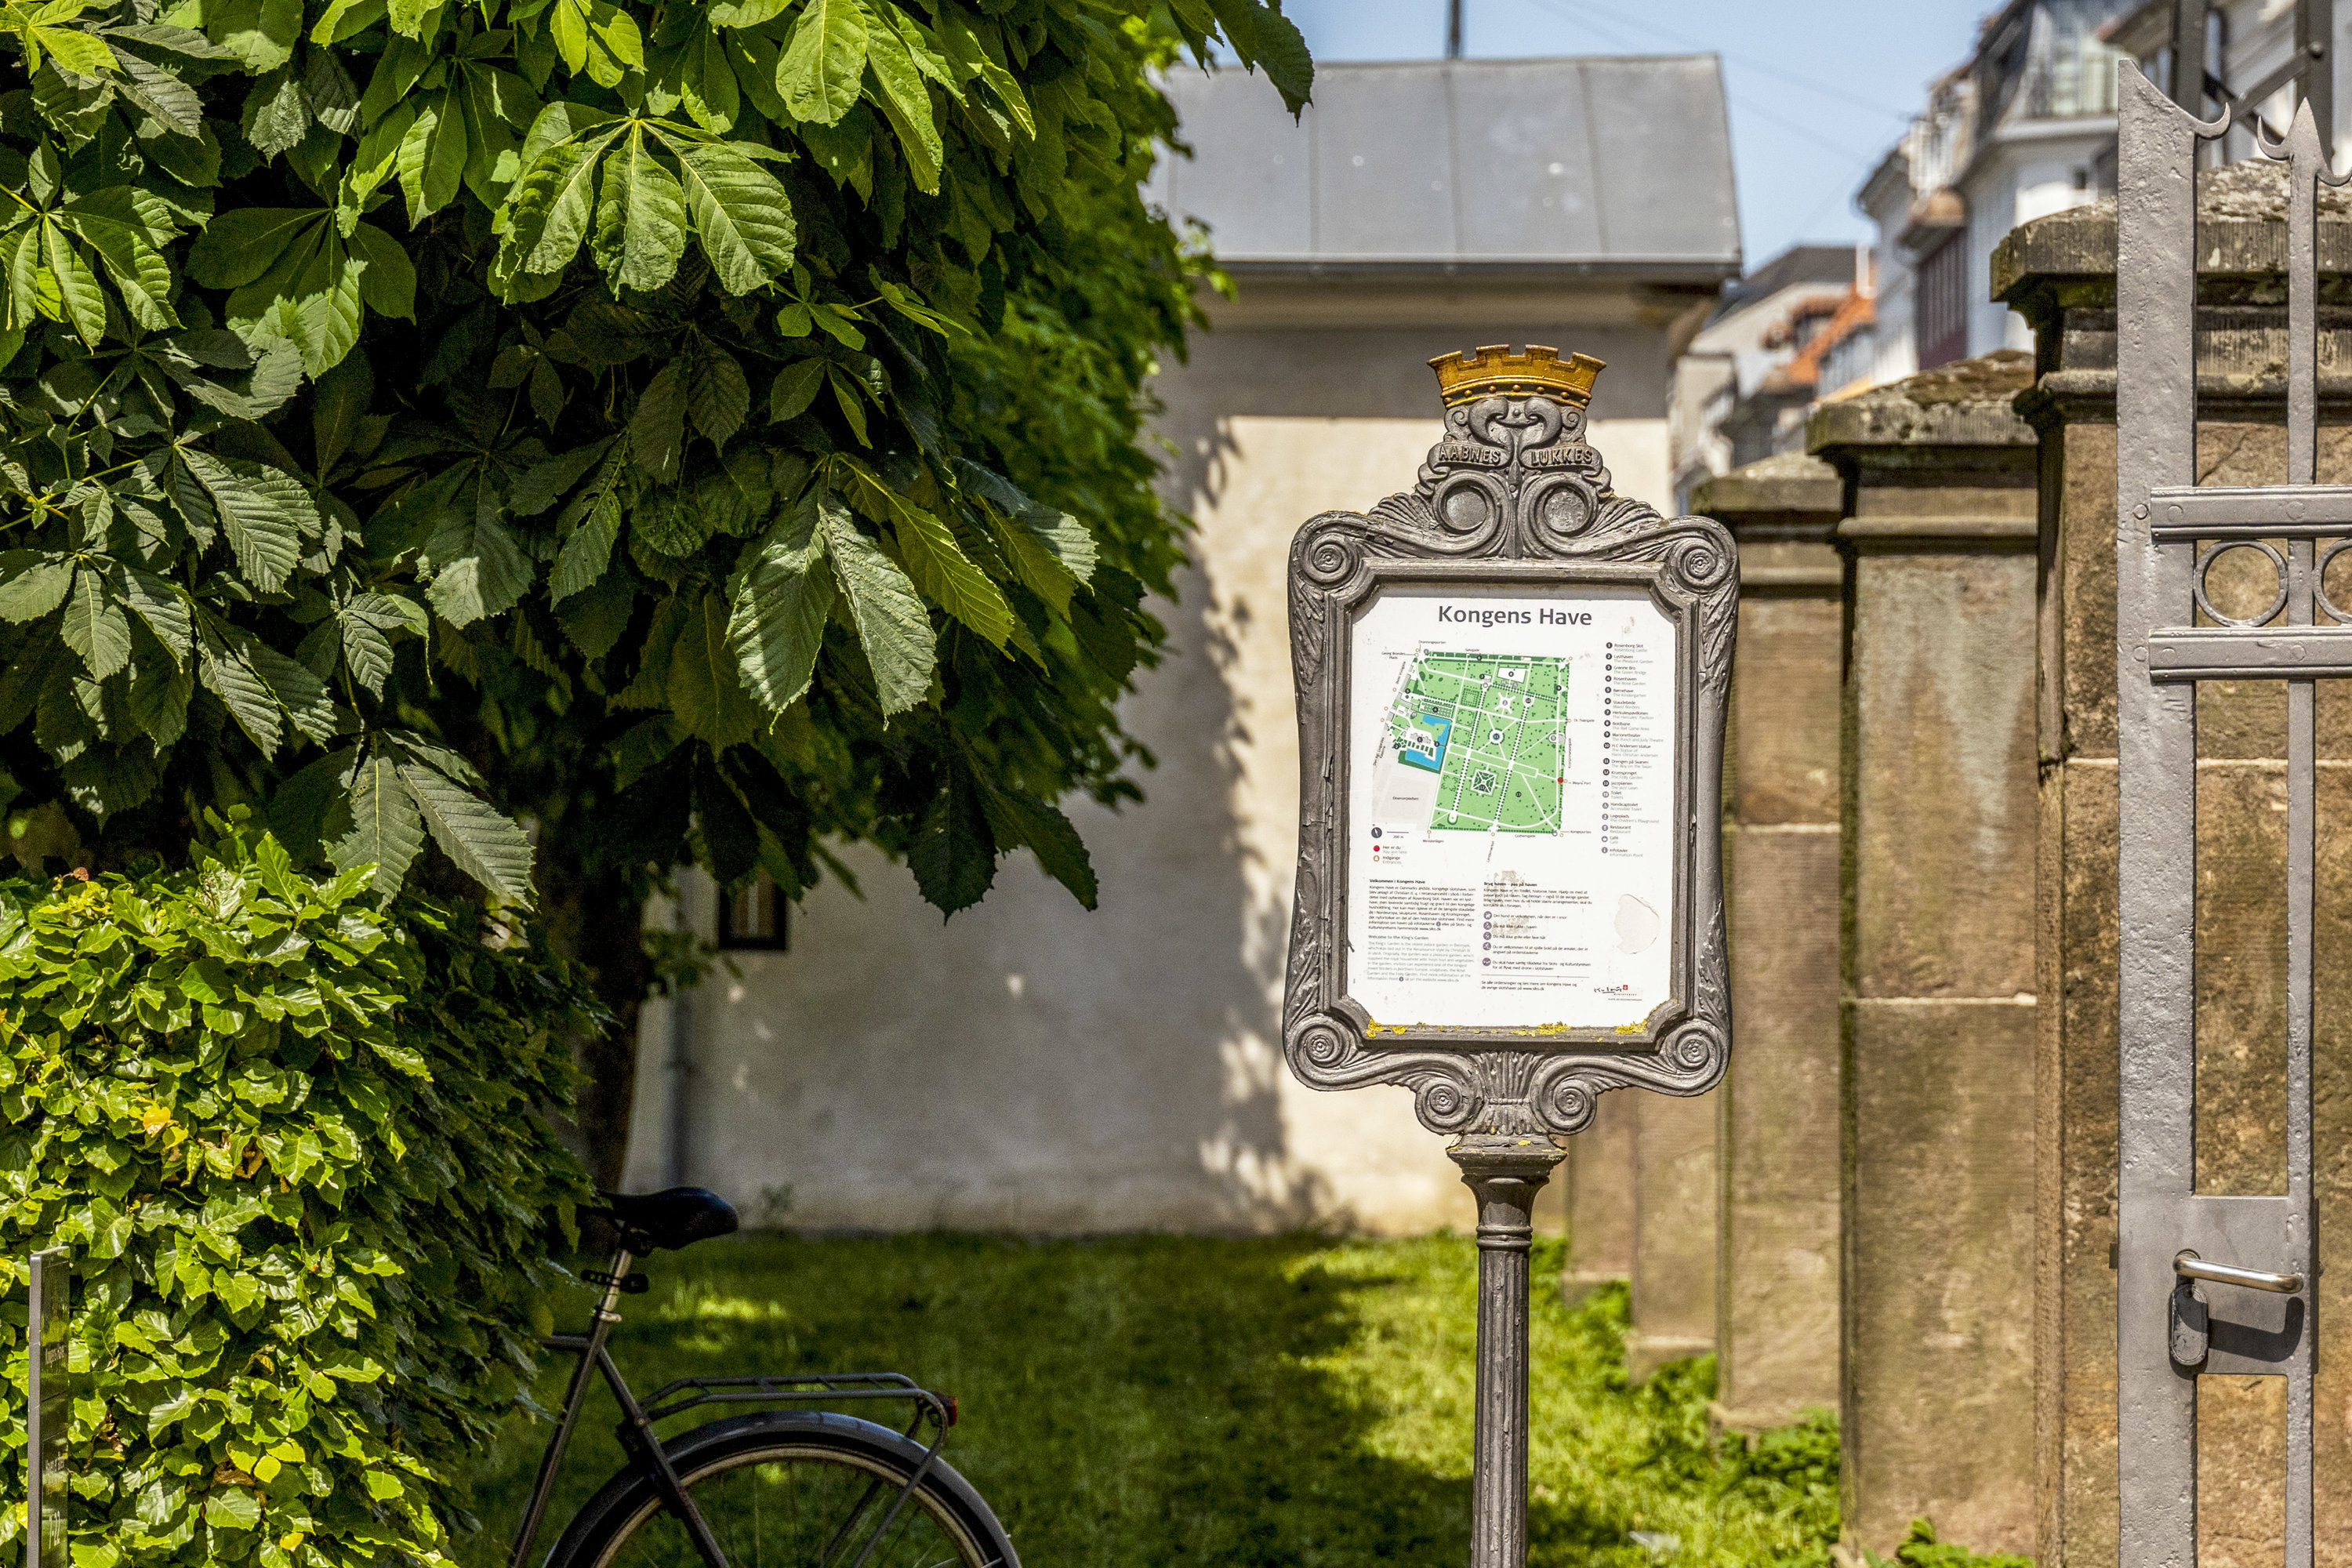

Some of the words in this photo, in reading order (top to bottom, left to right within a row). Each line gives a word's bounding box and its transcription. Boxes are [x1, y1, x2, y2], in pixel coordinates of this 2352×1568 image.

[1439, 445, 1501, 466] AABNES
[1530, 448, 1593, 467] LUKKES
[1439, 606, 1531, 627] Kongens
[1539, 608, 1592, 626] Have
